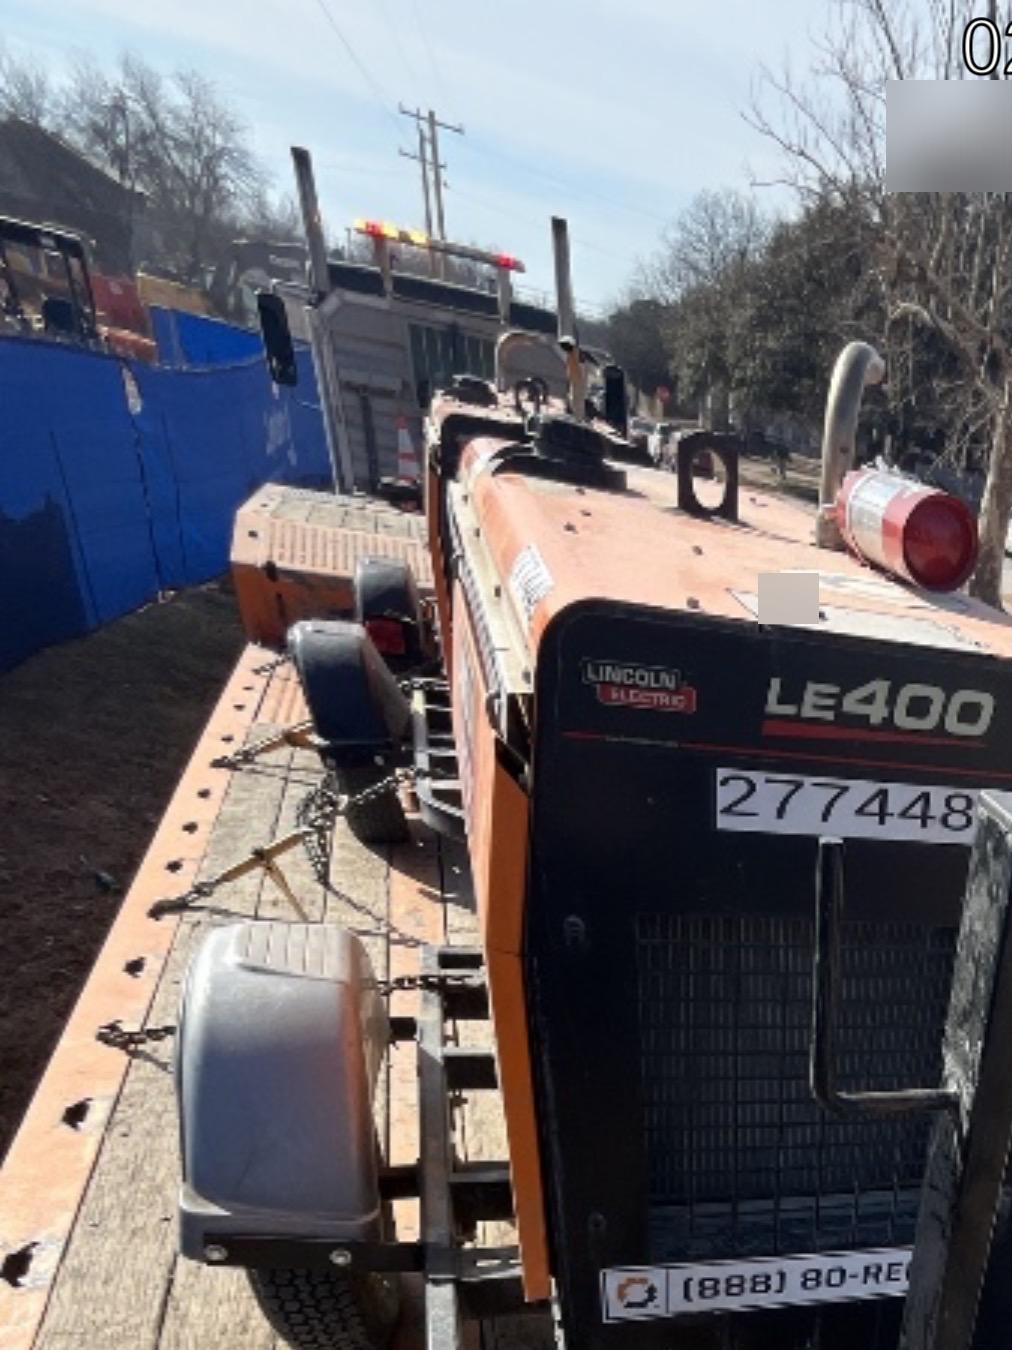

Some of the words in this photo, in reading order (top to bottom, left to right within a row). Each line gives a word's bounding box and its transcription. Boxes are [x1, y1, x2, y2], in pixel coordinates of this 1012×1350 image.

[586, 661, 677, 690] LINCOLN
[610, 686, 686, 708] ELECTRIC
[764, 677, 996, 737] LE400
[717, 774, 974, 832] 277448
[683, 1267, 786, 1303] (888)
